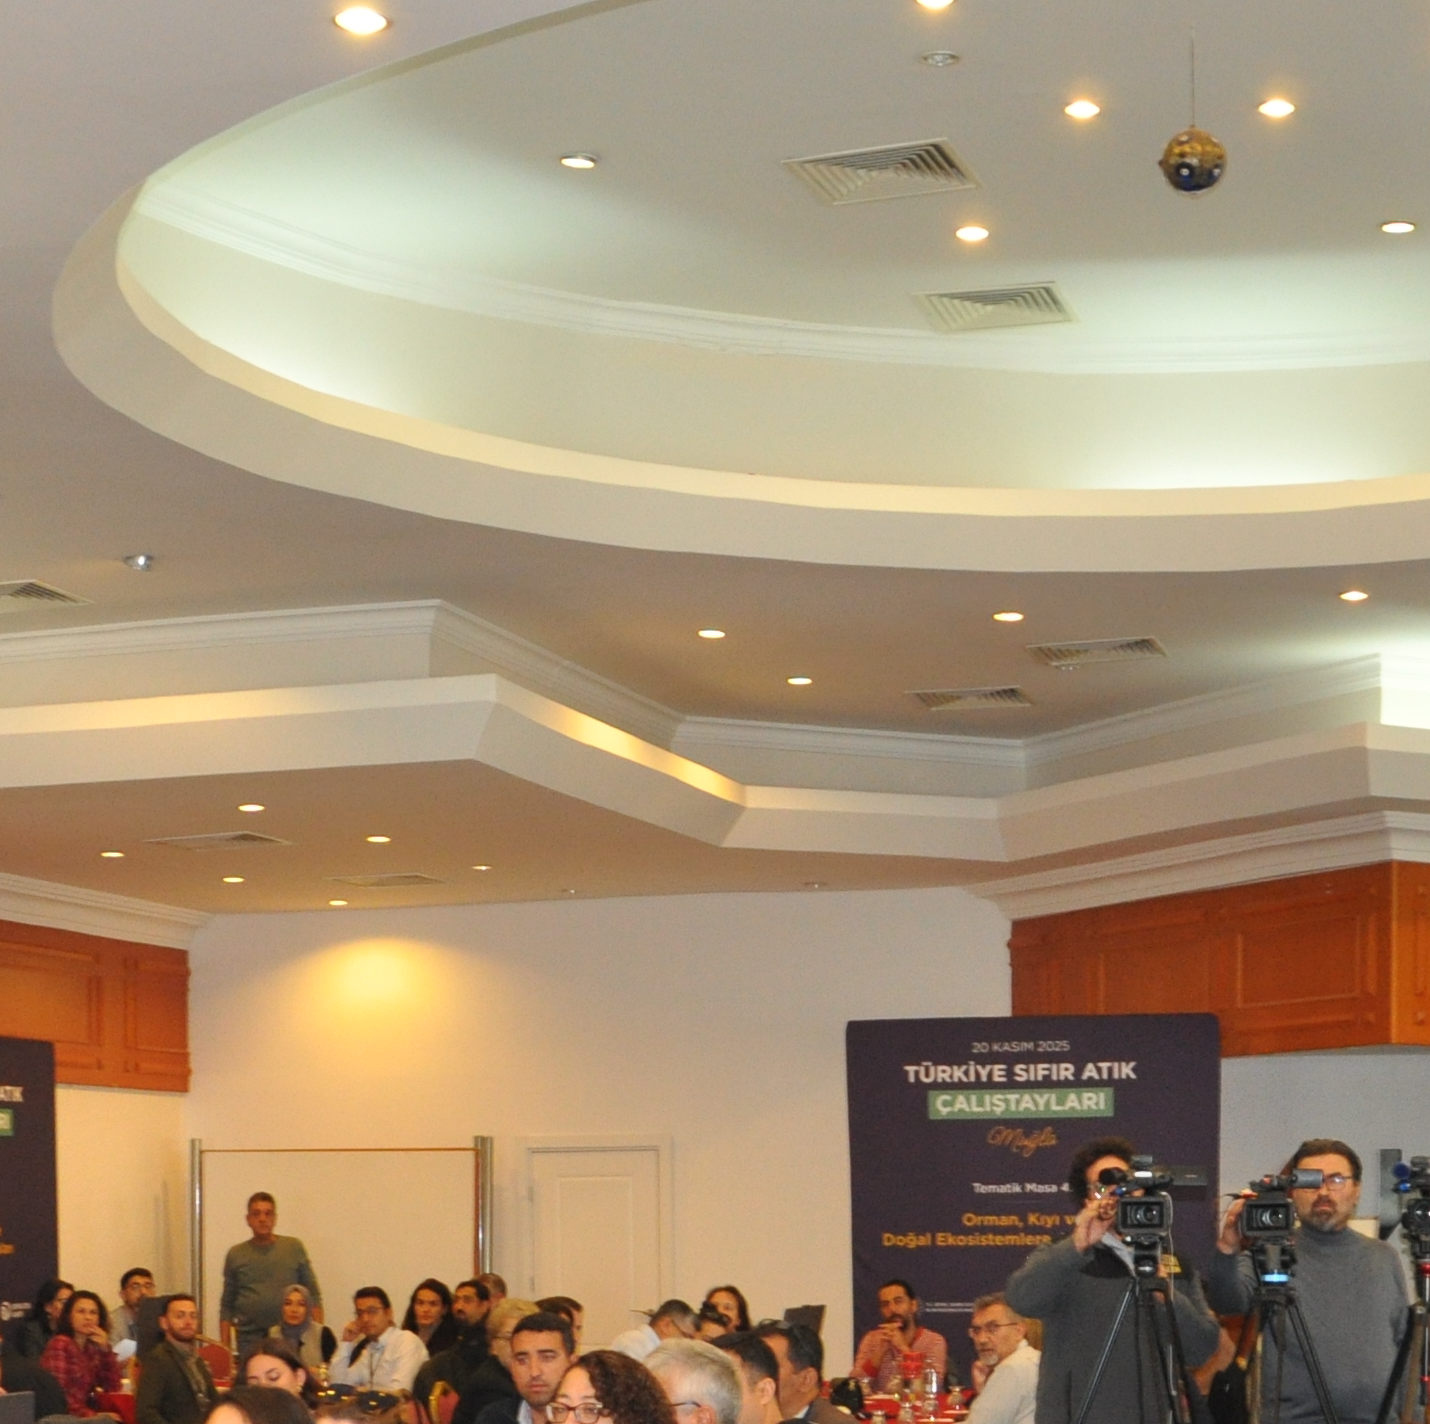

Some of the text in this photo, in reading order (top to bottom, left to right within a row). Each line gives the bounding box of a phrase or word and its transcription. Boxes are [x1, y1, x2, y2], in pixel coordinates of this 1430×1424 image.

[972, 1040, 1070, 1053] 20 KASIM 2025
[903, 1060, 1137, 1083] TÜRKİYE SIFIR ATIK
[935, 1092, 1106, 1116] ÇALIŞTAYLARI
[972, 1182, 1022, 1193] Tematik
[1024, 1183, 1058, 1193] Masa
[962, 1212, 1024, 1228] Orman,
[1028, 1212, 1060, 1228] Kıyı
[882, 1232, 931, 1248] Doğal
